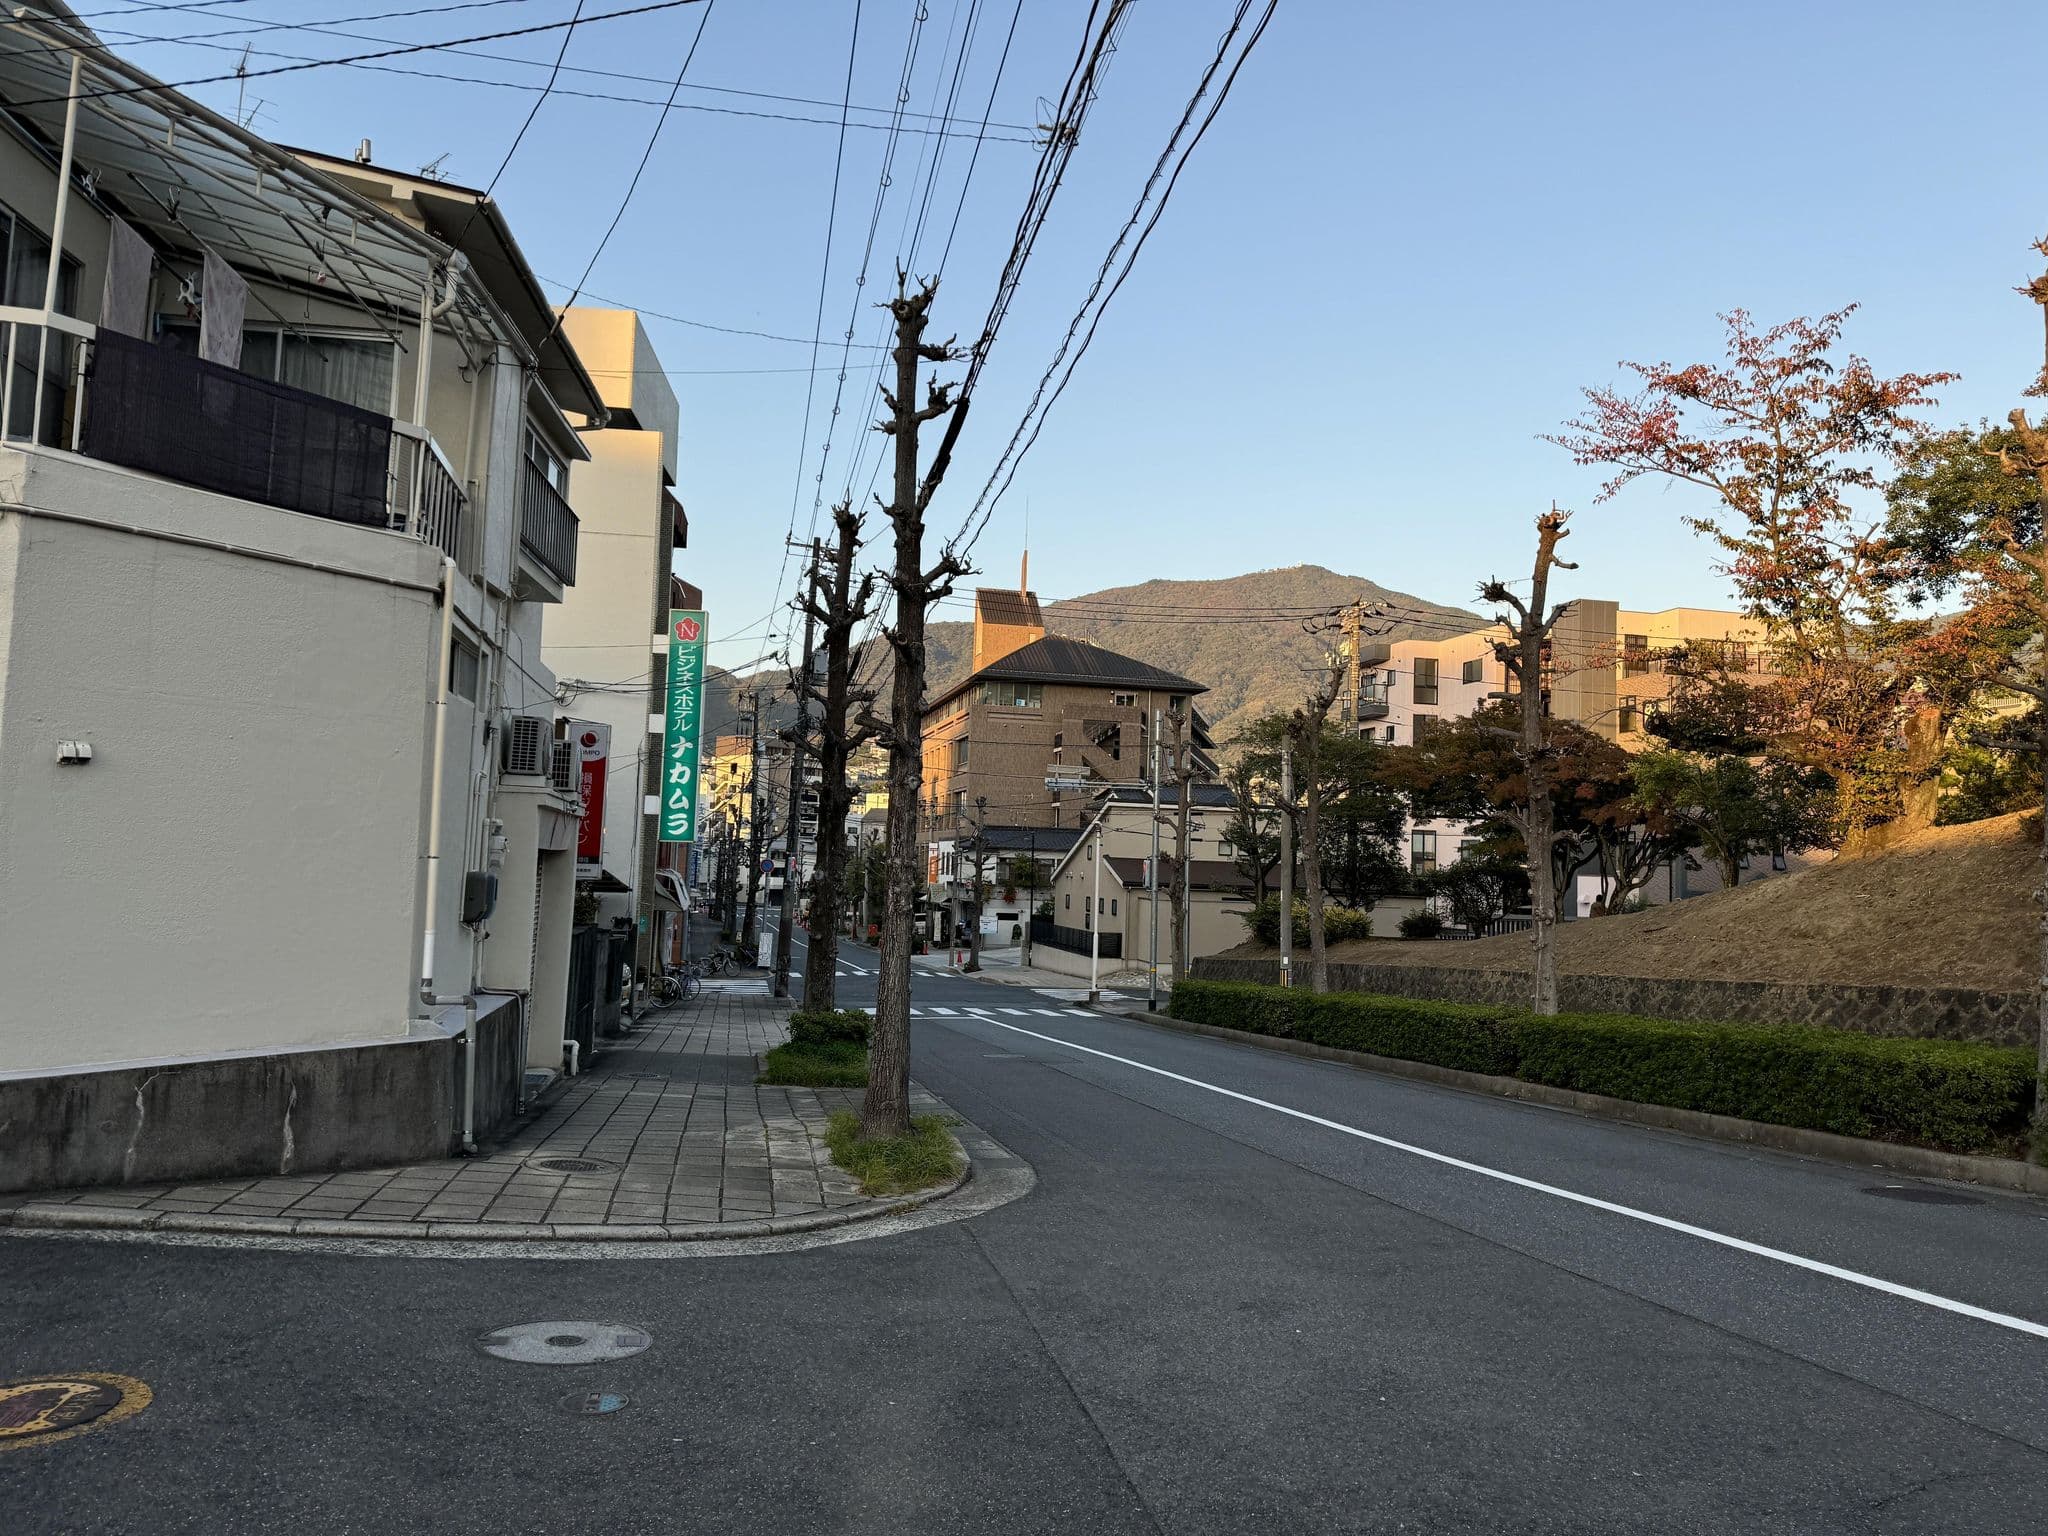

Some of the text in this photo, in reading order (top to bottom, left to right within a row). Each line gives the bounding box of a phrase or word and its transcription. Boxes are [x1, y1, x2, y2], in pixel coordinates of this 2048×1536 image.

[680, 622, 695, 638] N
[666, 645, 697, 836] ビジネスホテル ナカムラ
